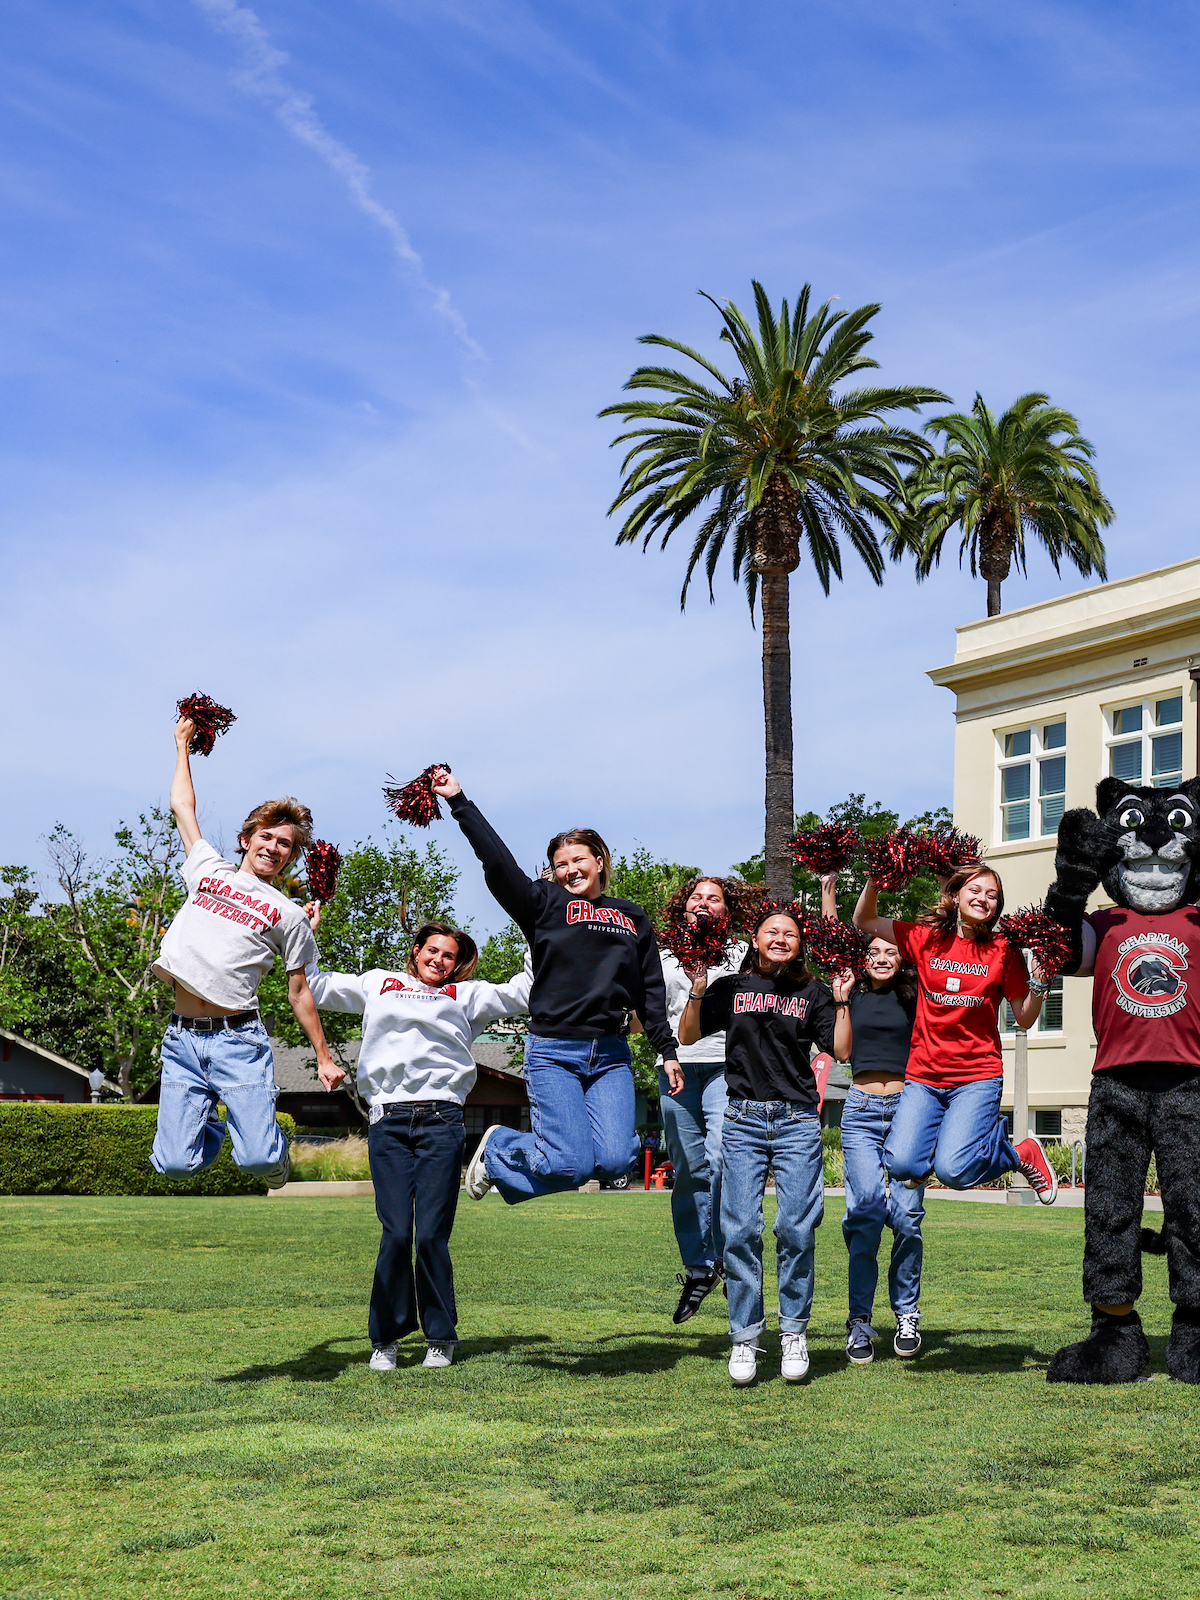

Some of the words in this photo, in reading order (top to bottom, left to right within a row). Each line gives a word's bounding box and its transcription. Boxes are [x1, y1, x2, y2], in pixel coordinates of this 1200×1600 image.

[197, 877, 282, 927] CHAPMAN
[192, 893, 272, 936] UNIVERSITY
[587, 924, 631, 936] UNIVERSITY
[1118, 932, 1190, 955] CHAPMAN
[930, 957, 989, 977] CHAPMAN
[396, 993, 438, 1001] UNIVERSITY
[734, 992, 809, 1020] CHAPMAN
[1116, 995, 1187, 1018] UNIVERSITY
